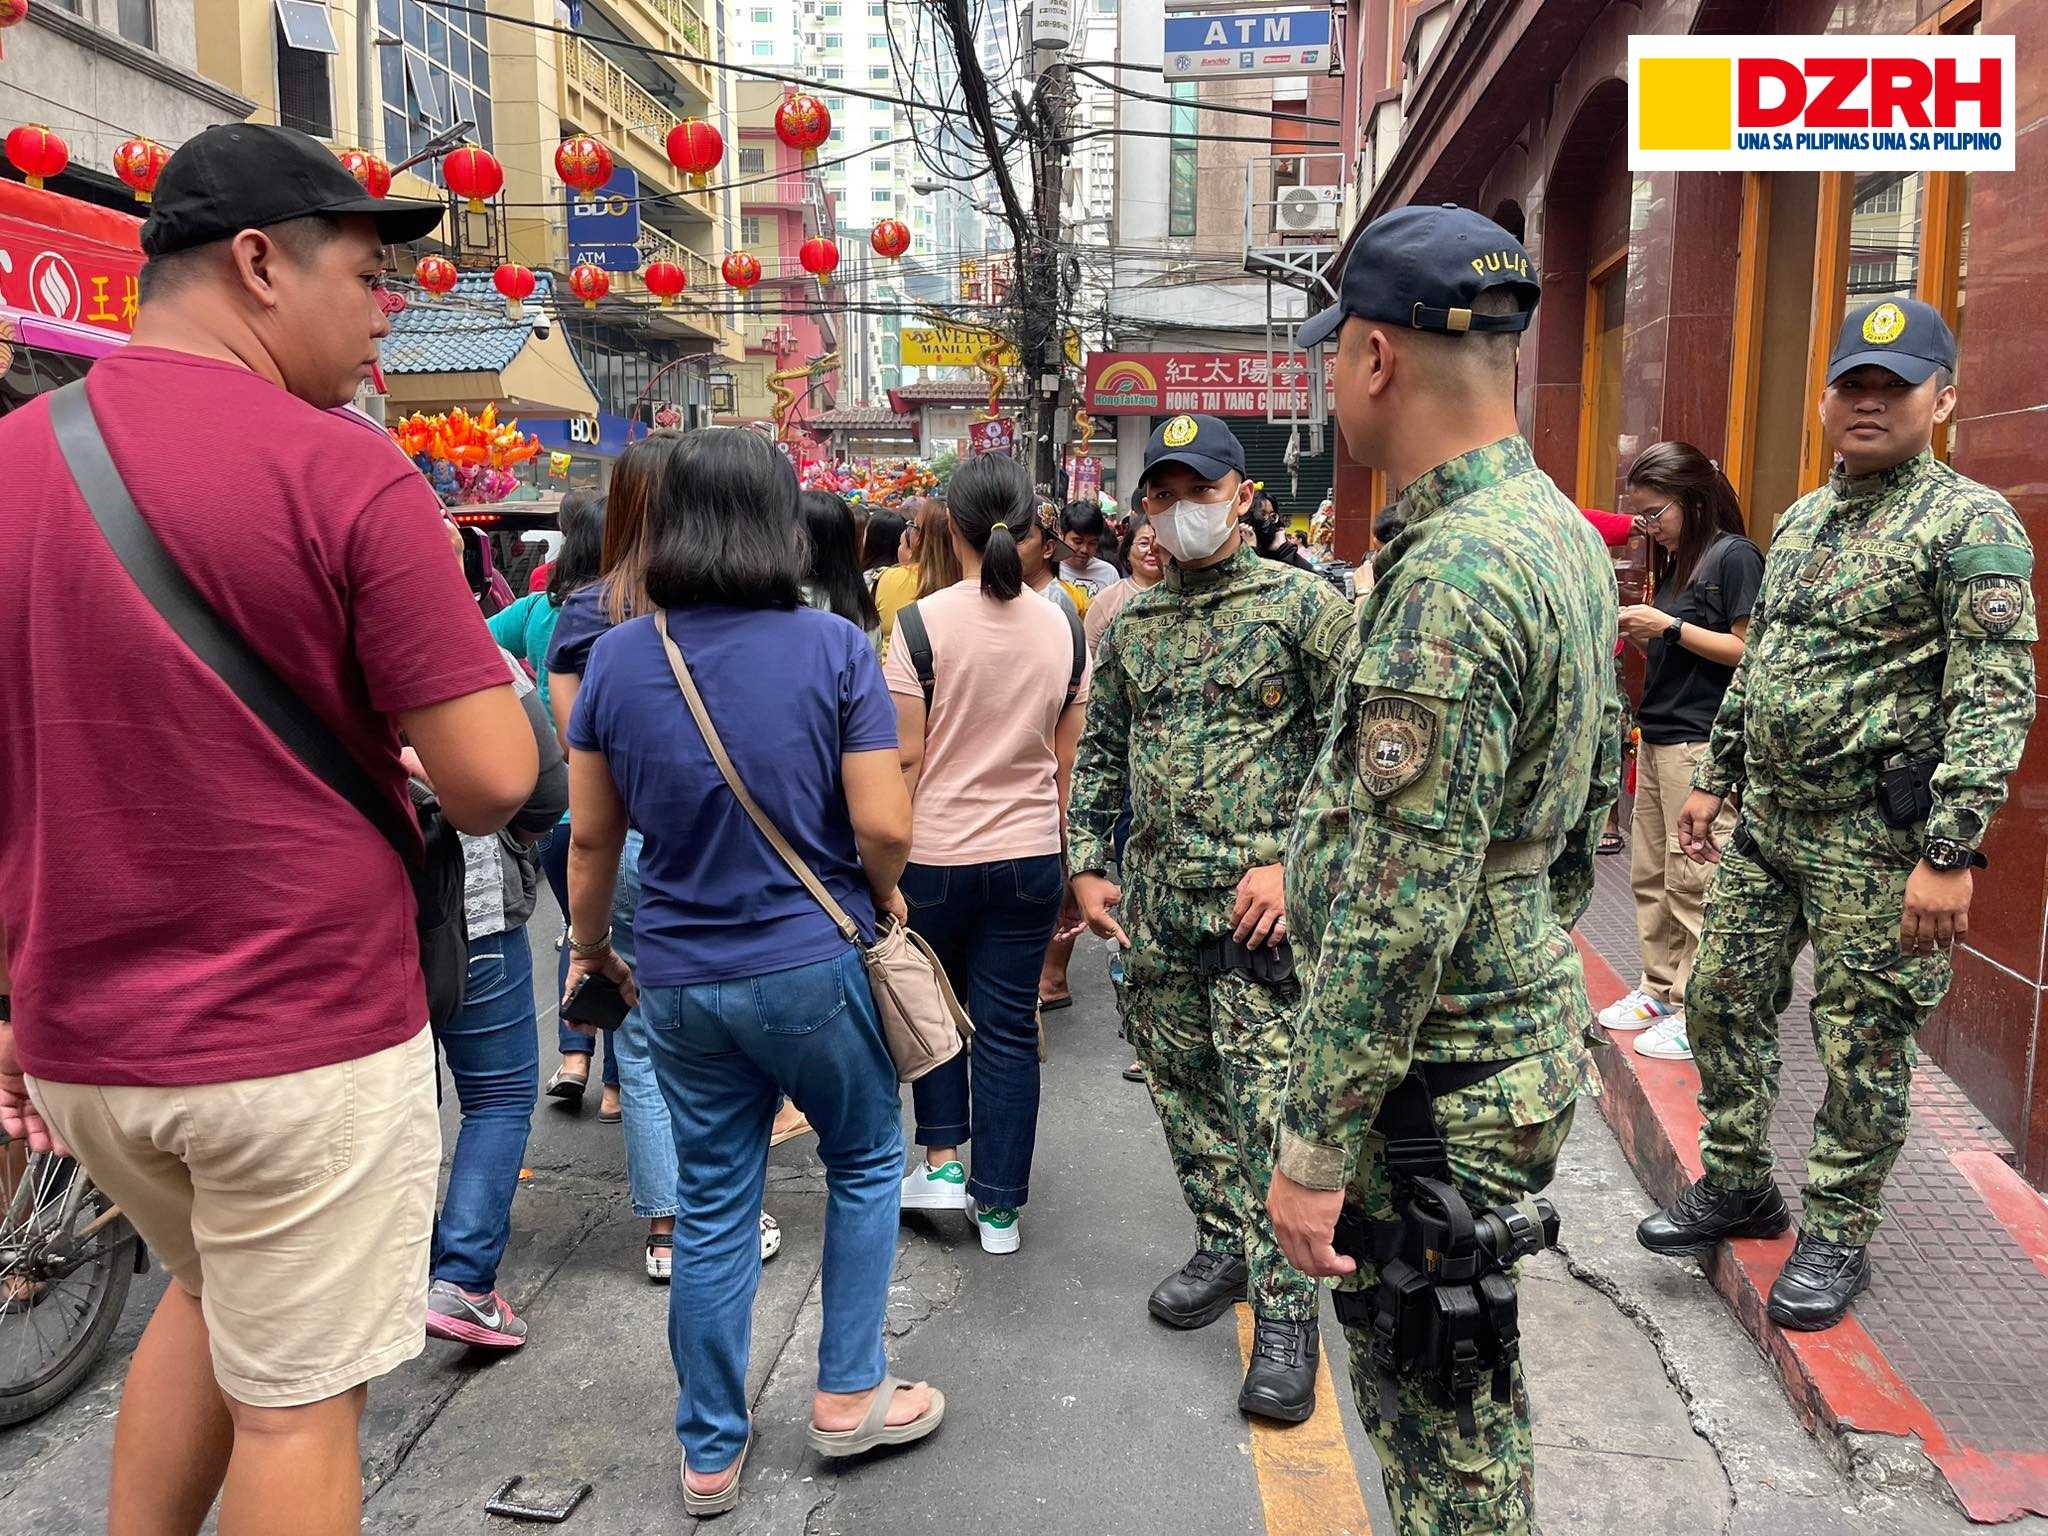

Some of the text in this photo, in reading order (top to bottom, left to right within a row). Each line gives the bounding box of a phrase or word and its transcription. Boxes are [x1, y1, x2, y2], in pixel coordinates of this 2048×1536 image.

[1203, 17, 1291, 45] ATM
[573, 195, 628, 216] BDO
[576, 252, 606, 264] ATM
[921, 344, 973, 354] MANILA
[1094, 394, 1157, 407] HongTaiYang
[1166, 392, 1198, 410] HONG
[1203, 392, 1221, 410] TAI
[1224, 392, 1253, 410] YANG
[1257, 392, 1308, 410] CINESE
[570, 418, 600, 445] BDO
